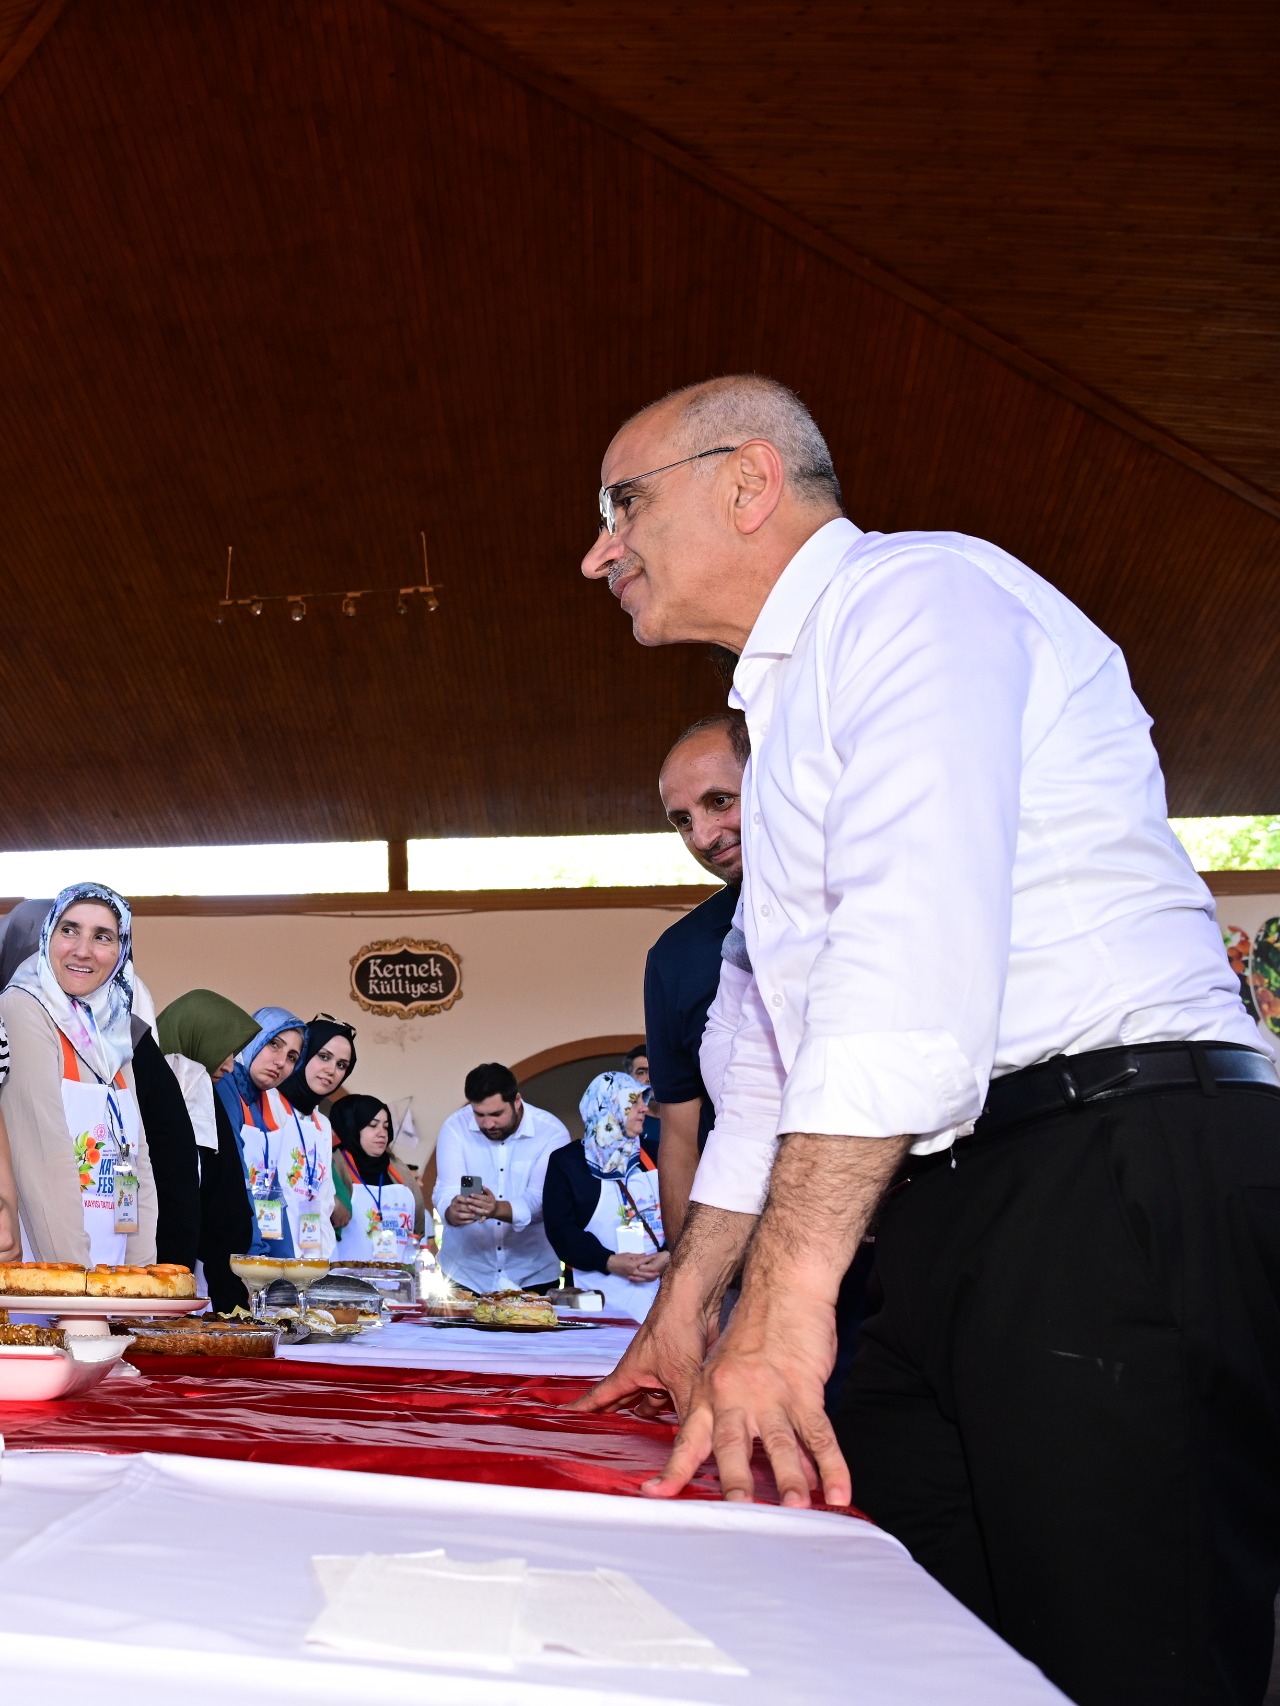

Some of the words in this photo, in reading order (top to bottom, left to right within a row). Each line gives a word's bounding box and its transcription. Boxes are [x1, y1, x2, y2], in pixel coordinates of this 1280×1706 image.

[368, 957, 443, 978] Kernek
[368, 978, 444, 998] Külliyesi
[97, 1176, 115, 1194] FES
